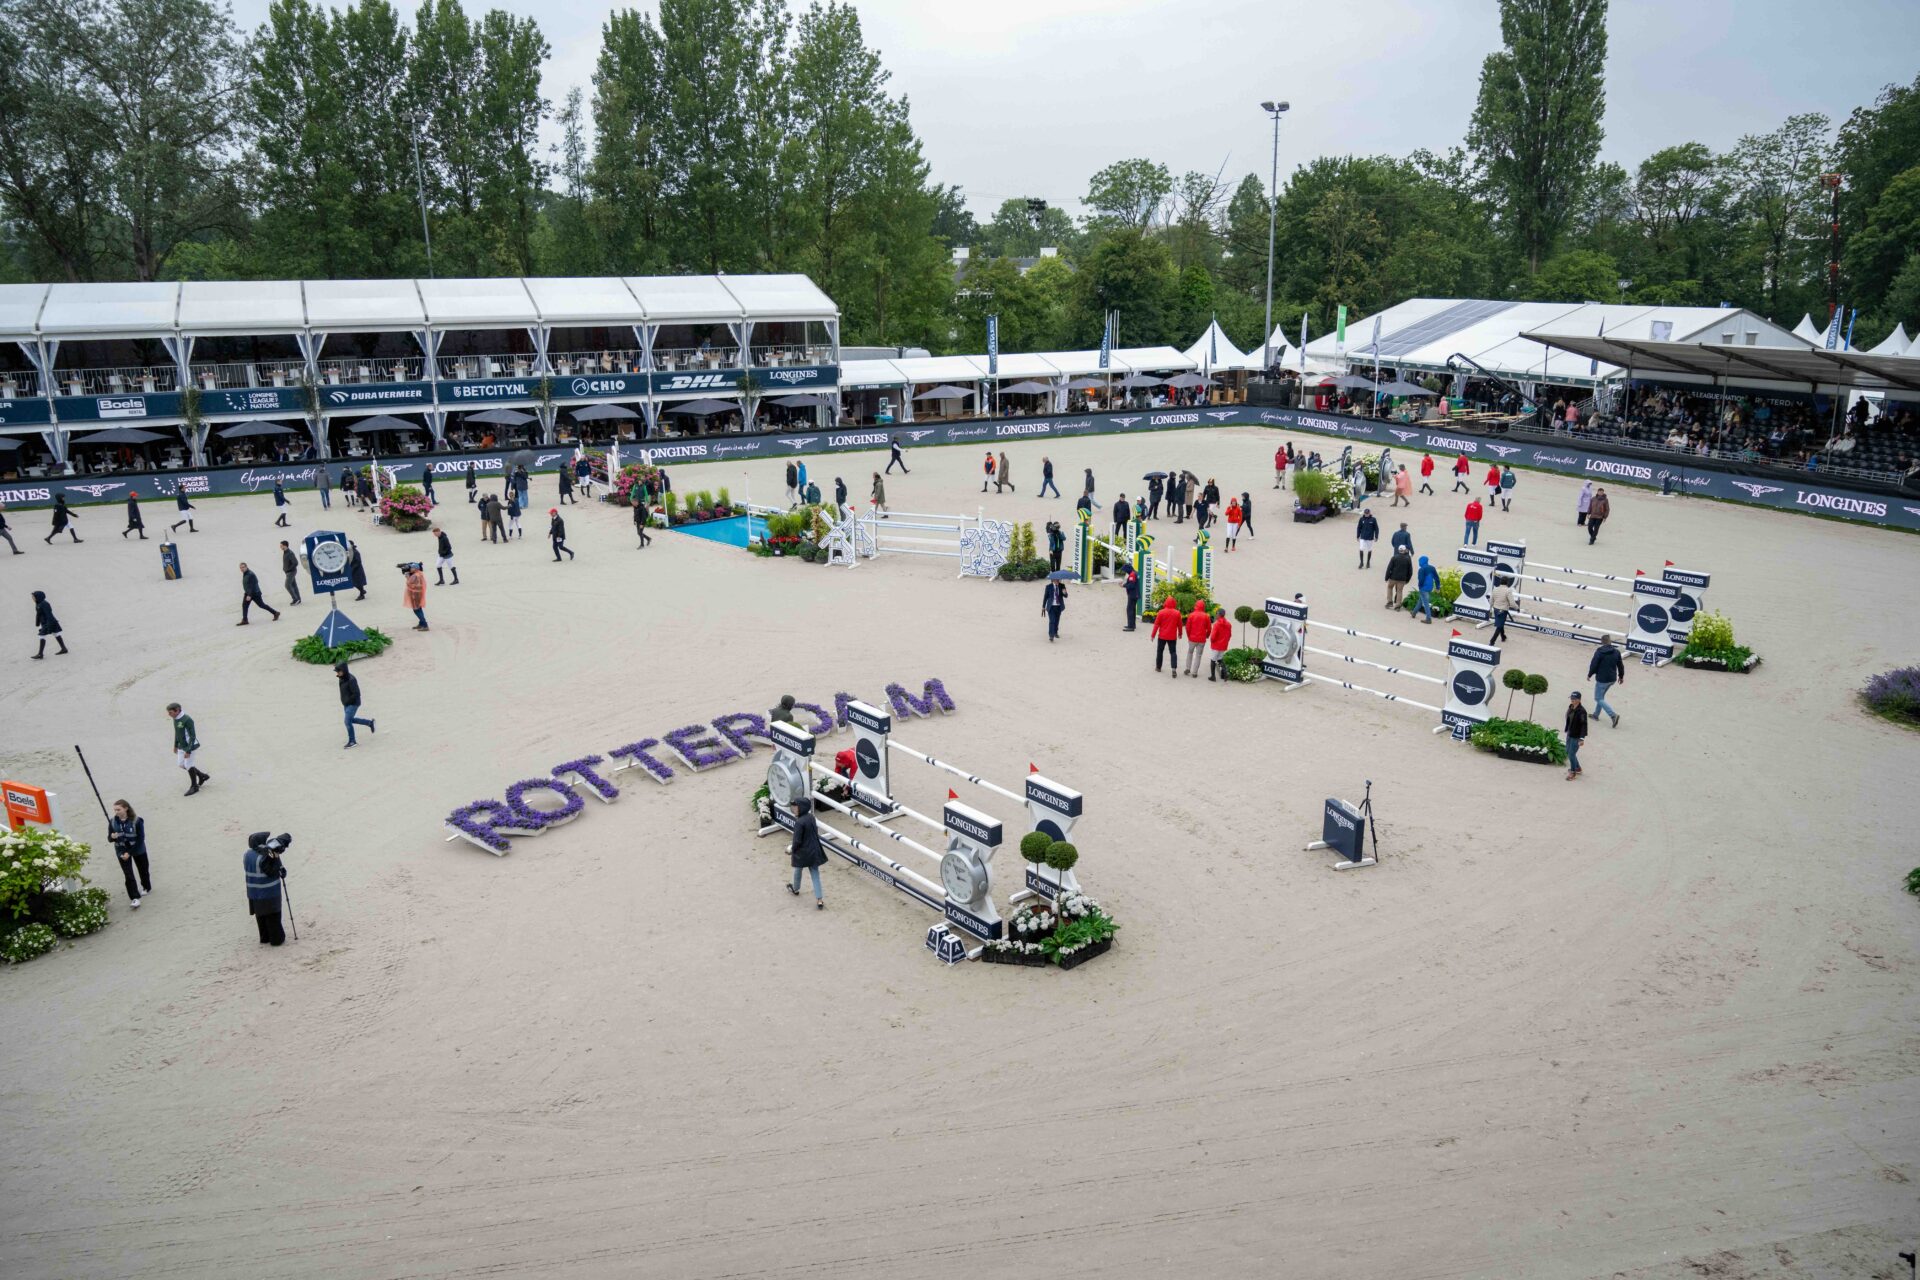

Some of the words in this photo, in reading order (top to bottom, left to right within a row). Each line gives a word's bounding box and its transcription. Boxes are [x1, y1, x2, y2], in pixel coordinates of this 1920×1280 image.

[672, 374, 728, 389] DHL
[770, 370, 818, 380] LONGINES
[462, 384, 528, 397] BETCITY.NL
[590, 380, 626, 391] CHIO
[100, 399, 143, 409] Boels
[1150, 414, 1199, 425] LONGINES
[1298, 417, 1338, 430] LONGINES
[996, 423, 1049, 435] LONGINES
[828, 434, 888, 446] LONGINES
[1427, 436, 1477, 452] LONGINES
[426, 458, 503, 473] LONGNES
[1585, 459, 1652, 480] LONGINES
[1796, 491, 1887, 516] LONGINES
[1489, 545, 1520, 555] LNGINES
[1460, 554, 1492, 564] LONGINES
[316, 577, 348, 586] LONGINES
[1665, 574, 1704, 584] LONGINES
[1636, 584, 1676, 595] LONGINES
[1267, 604, 1300, 616] LONGINES
[1455, 608, 1486, 618] LONGINES
[1538, 627, 1573, 638] LONGINES
[1452, 646, 1492, 661] LONGINES
[1628, 642, 1667, 655] LONGINES
[1264, 666, 1296, 679] LONGINES
[849, 710, 879, 729] LONGINES
[772, 730, 802, 751] LONGINES
[8, 792, 35, 806] Boels
[852, 788, 881, 808] LONGINES
[1028, 785, 1069, 811] LONGINES
[776, 812, 795, 828] LONGI
[1327, 806, 1355, 831] LONGINES
[946, 813, 988, 840] LONGINES
[860, 860, 894, 886] LONGINES
[1028, 876, 1060, 896] LONGIN
[948, 907, 988, 936] LONGINES
[931, 931, 935, 940] 7
[942, 943, 948, 952] A
[955, 943, 960, 952] A
